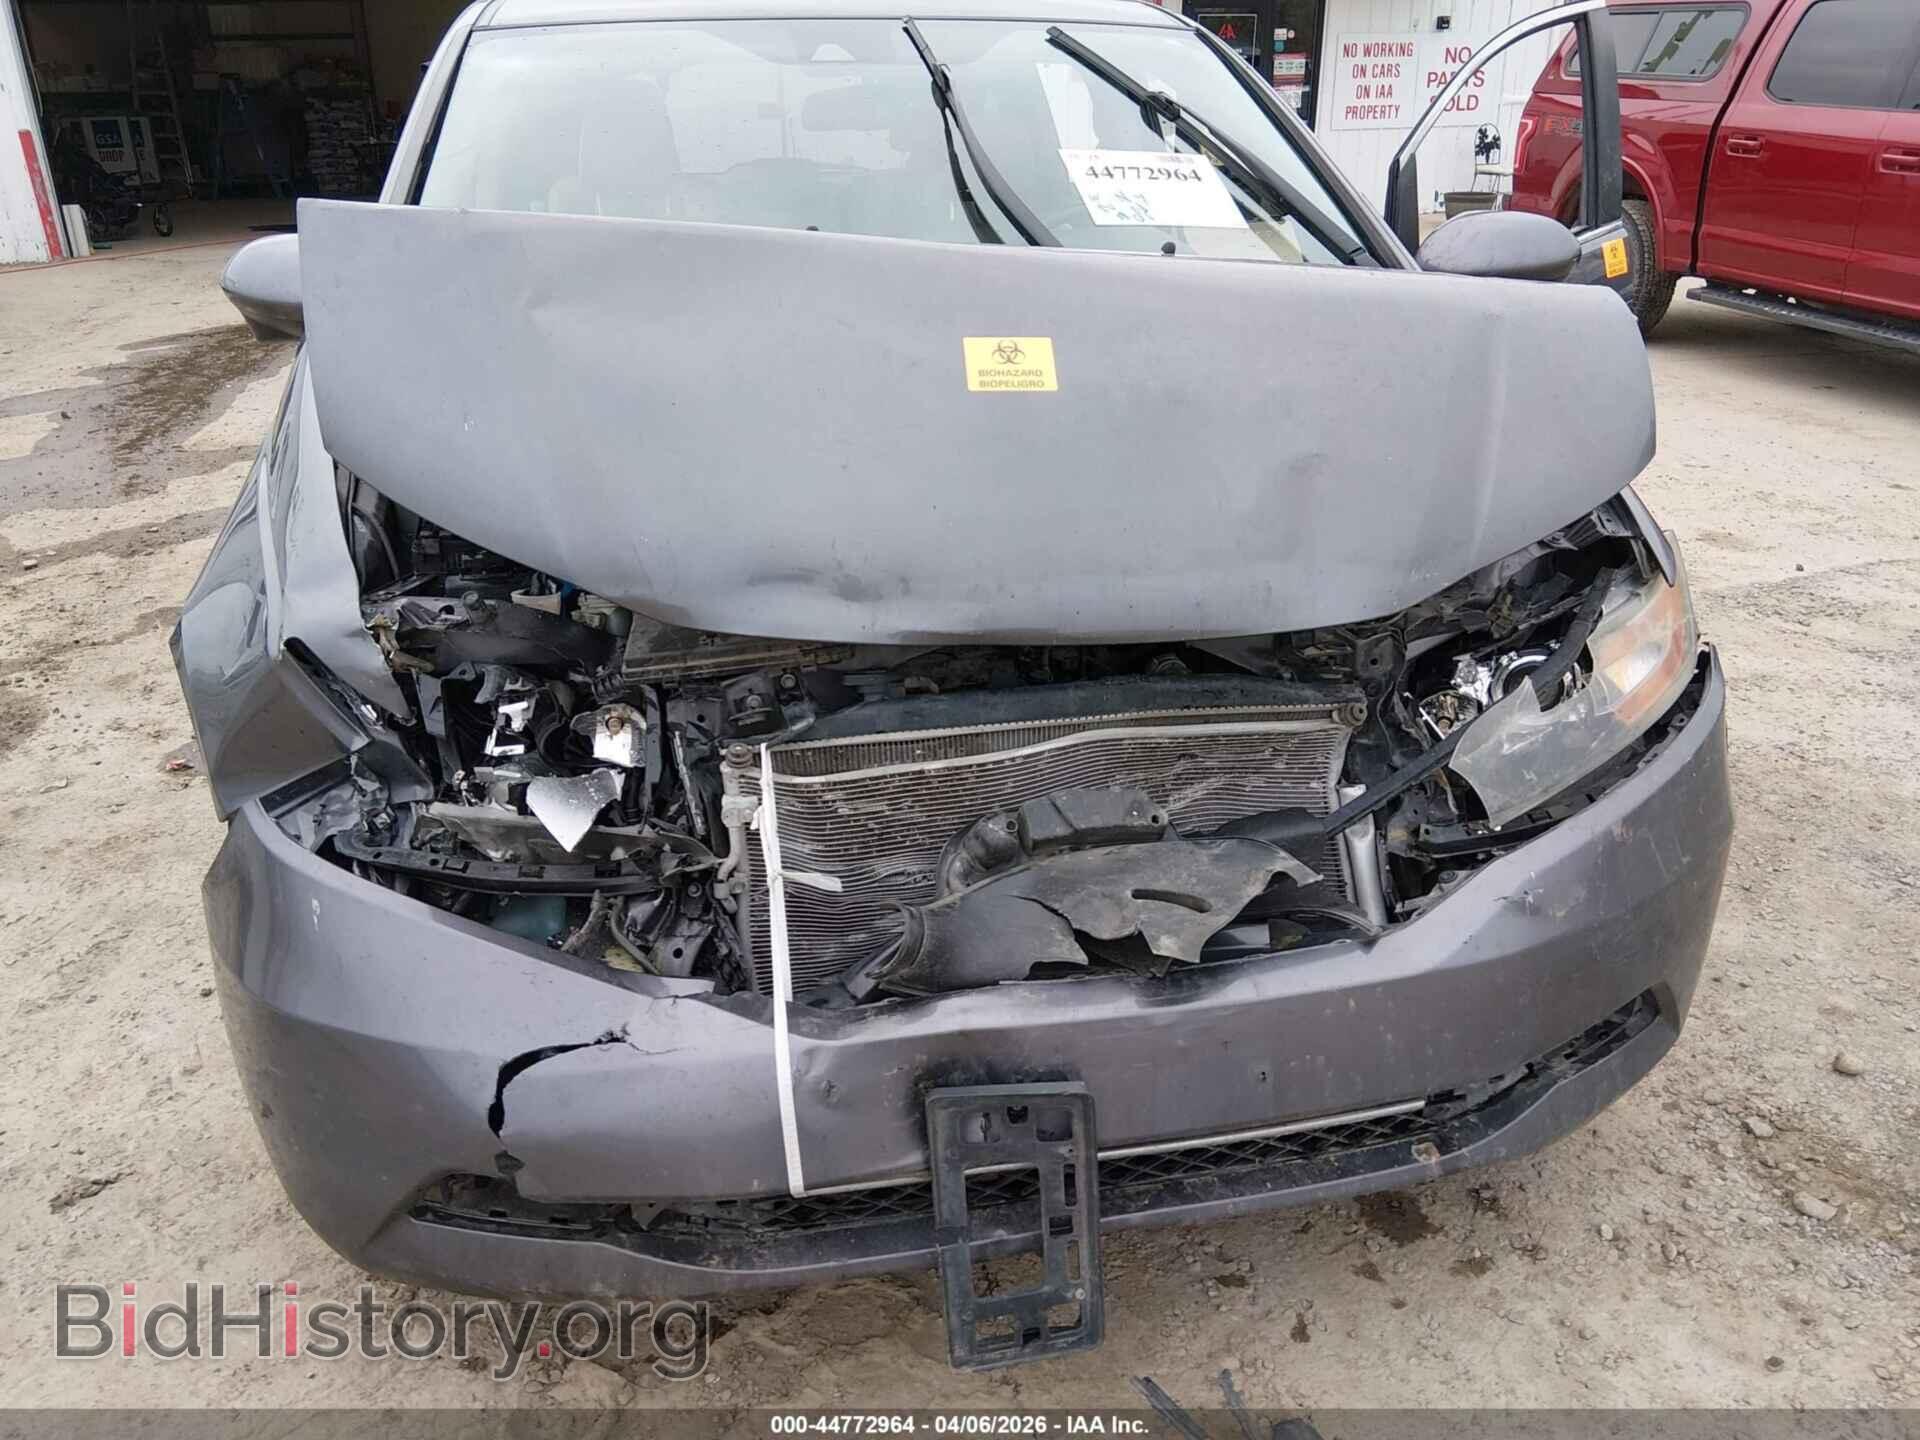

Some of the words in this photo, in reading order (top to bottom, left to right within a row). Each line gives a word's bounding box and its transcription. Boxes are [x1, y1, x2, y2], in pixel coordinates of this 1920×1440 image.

[1343, 43, 1358, 58] NO
[1363, 42, 1414, 58] WORKING
[1444, 46, 1472, 64] NO
[1352, 64, 1367, 79] ON
[1371, 63, 1401, 78] CARS
[1355, 84, 1371, 100] ON
[1375, 84, 1393, 99] IAA
[1345, 104, 1401, 120] PROPERTY
[1085, 165, 1203, 182] 44772964
[978, 368, 1043, 378] BIOHAZARD
[979, 379, 1045, 389] BIOPELIGRO
